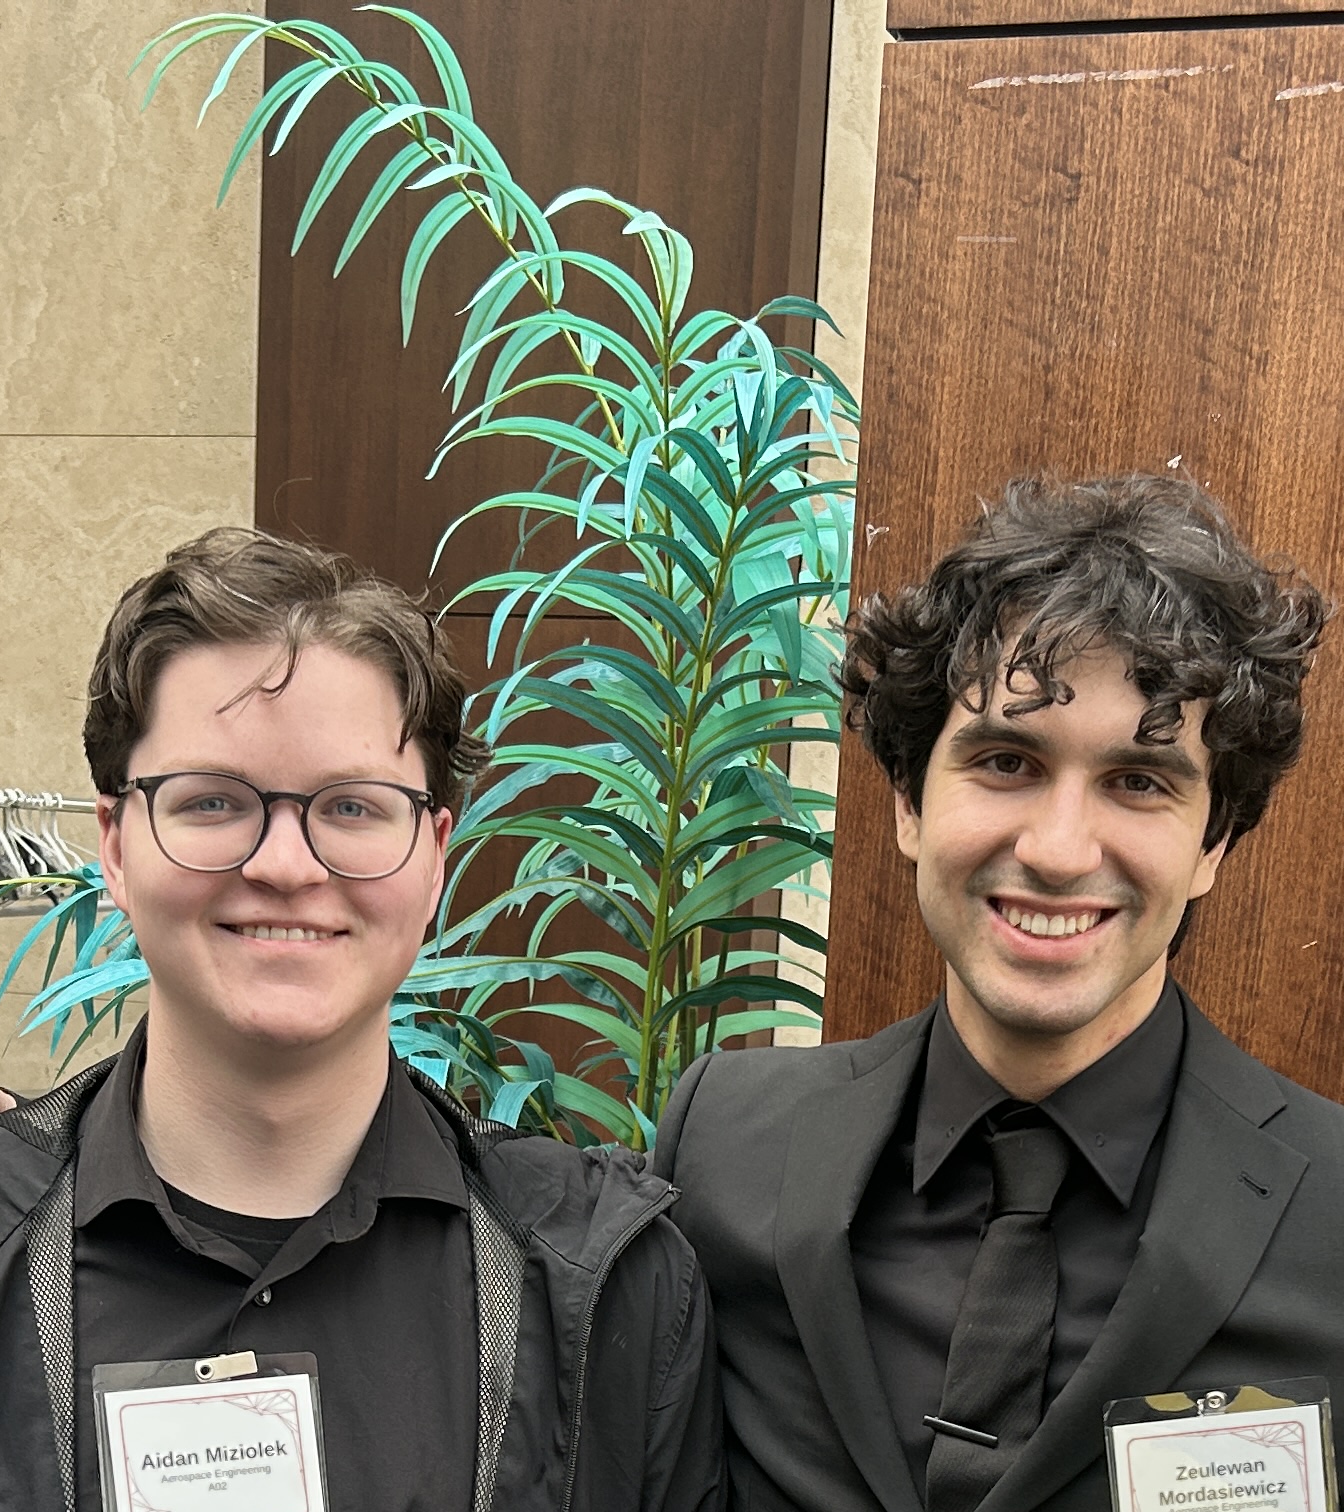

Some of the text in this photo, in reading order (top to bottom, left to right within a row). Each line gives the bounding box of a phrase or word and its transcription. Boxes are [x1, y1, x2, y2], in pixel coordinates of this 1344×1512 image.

[141, 1440, 288, 1470] Aidan Miziolek
[161, 1464, 271, 1484] Aerospace Engineering
[1176, 1459, 1265, 1481] Zeulewan
[1159, 1480, 1287, 1506] Mordasiewicz
[1222, 1498, 1278, 1512] Engineering
